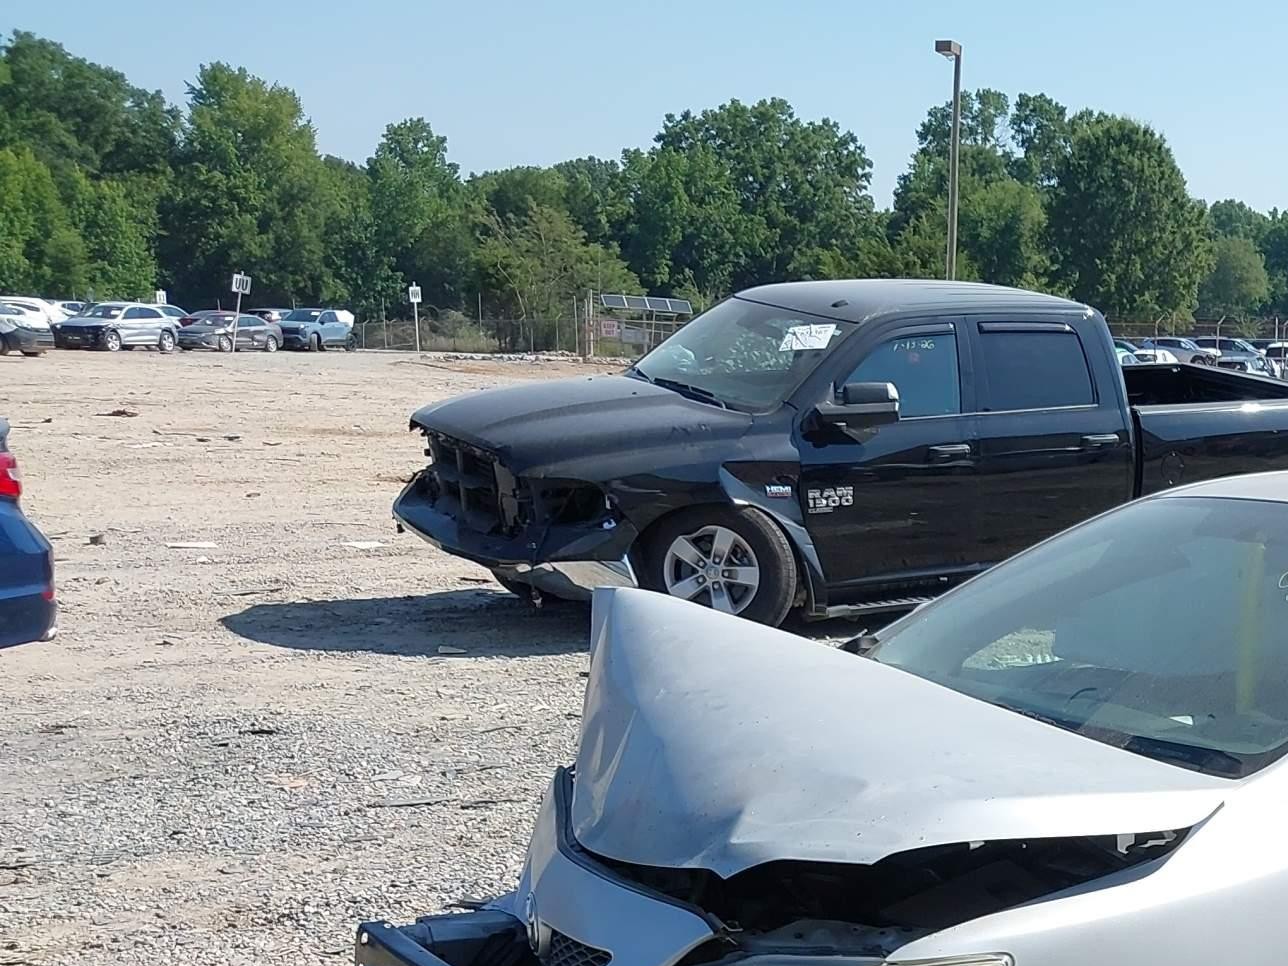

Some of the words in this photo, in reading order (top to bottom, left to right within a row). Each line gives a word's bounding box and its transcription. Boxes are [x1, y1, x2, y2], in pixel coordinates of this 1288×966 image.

[235, 277, 248, 291] UU
[765, 485, 792, 493] HEMI
[808, 486, 854, 499] RAM
[808, 496, 854, 508] 1500
